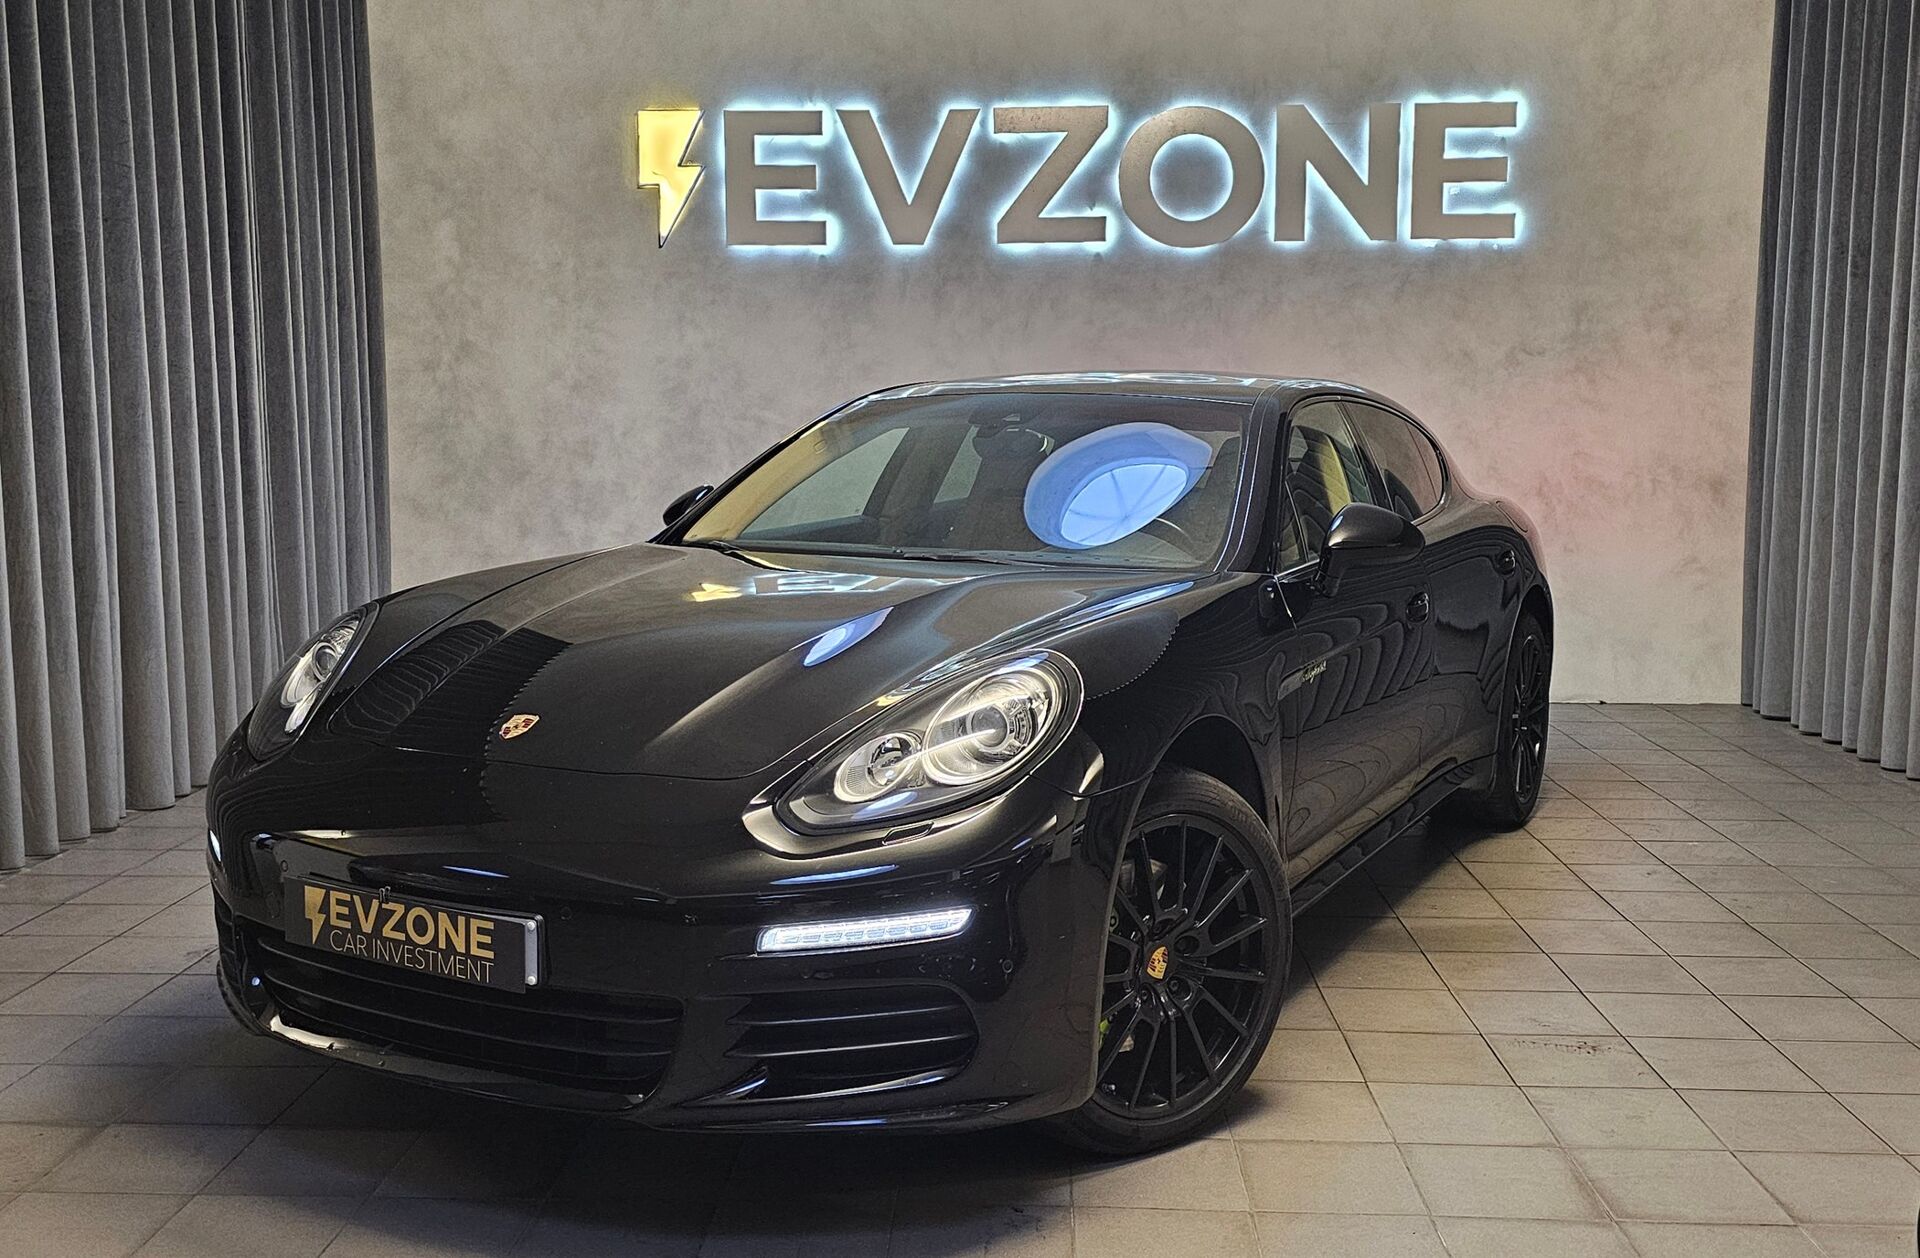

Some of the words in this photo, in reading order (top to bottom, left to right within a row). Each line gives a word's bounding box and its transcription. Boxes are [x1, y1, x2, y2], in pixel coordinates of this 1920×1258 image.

[723, 100, 1519, 248] EVZONE
[329, 889, 495, 960] EVZONE
[329, 929, 368, 957] CAR
[372, 940, 495, 983] INVESTMENT
